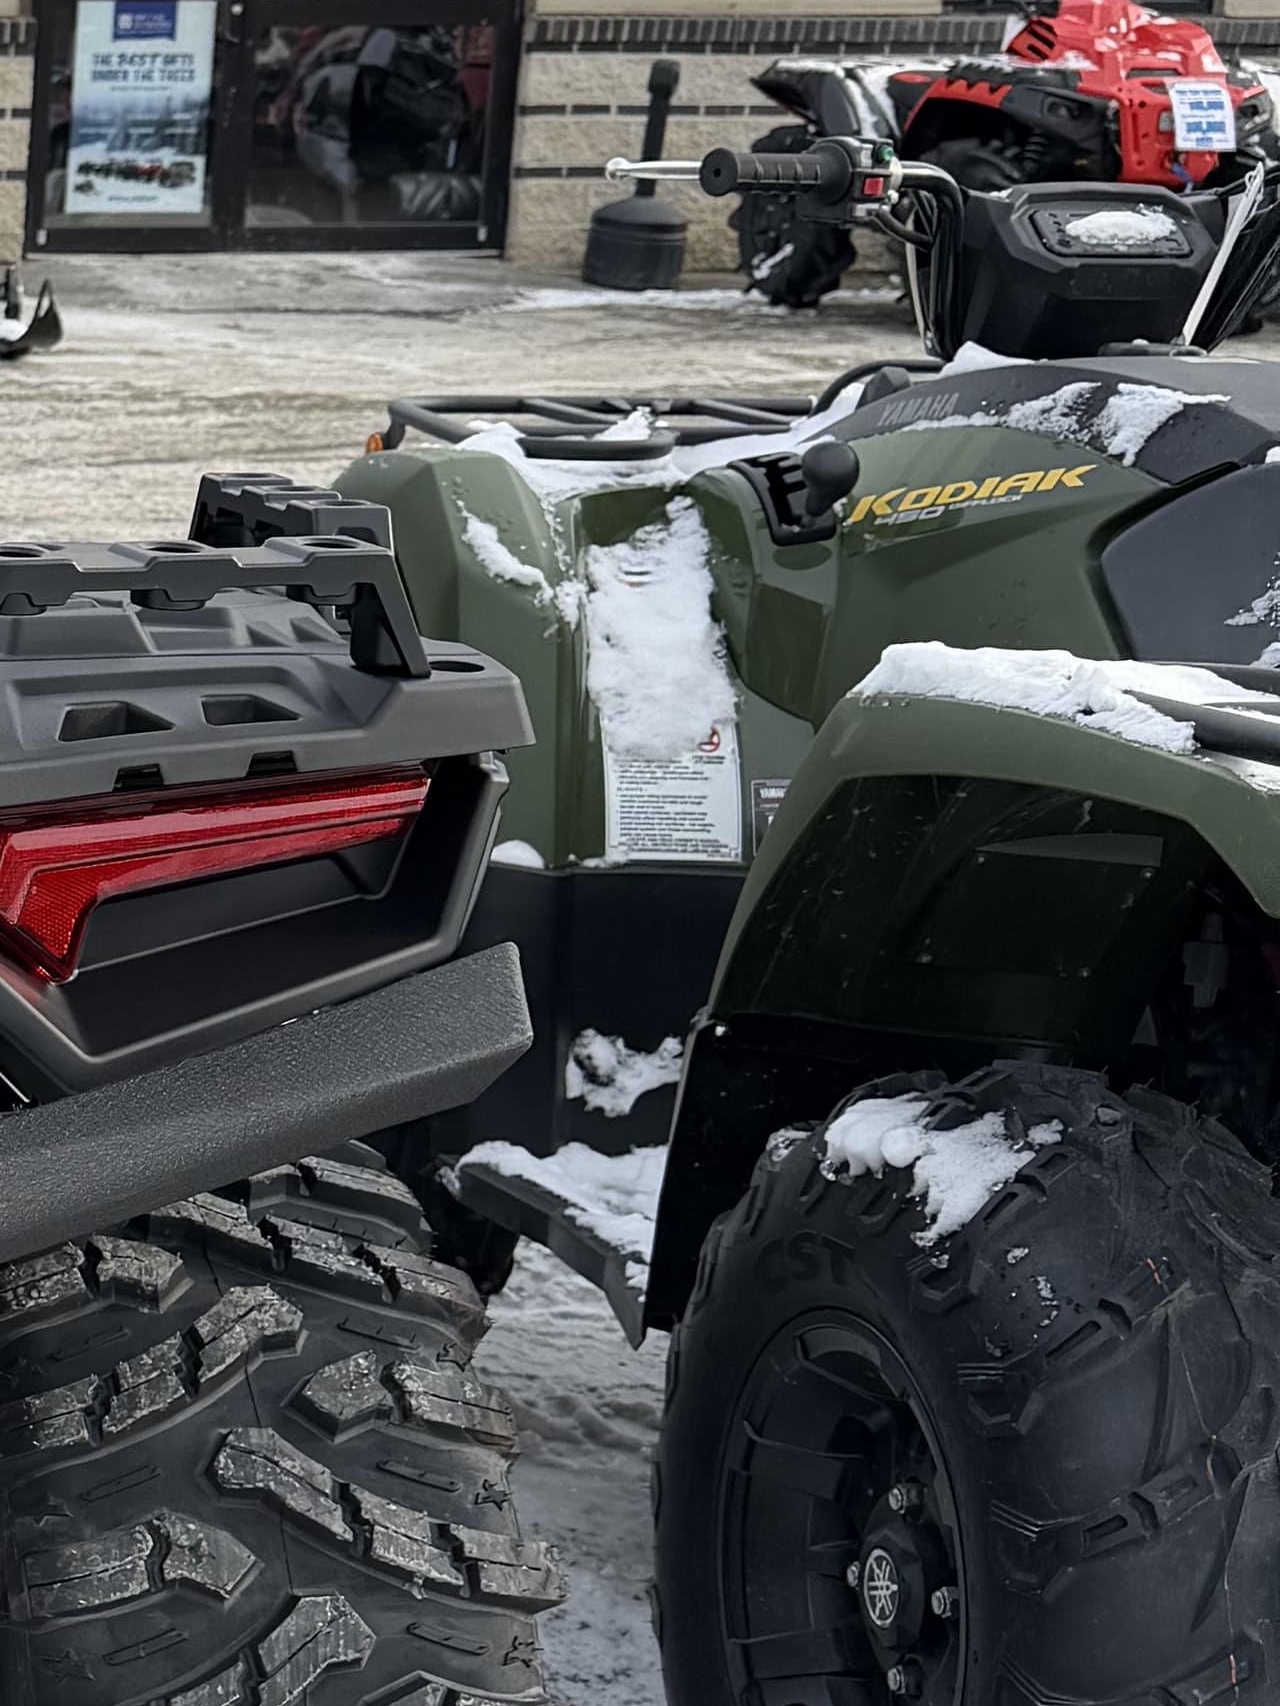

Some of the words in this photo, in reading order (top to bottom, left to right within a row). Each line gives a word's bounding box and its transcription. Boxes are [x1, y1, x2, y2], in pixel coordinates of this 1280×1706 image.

[877, 391, 961, 428] YAMAHA
[843, 464, 1098, 525] KODIAK
[873, 506, 947, 526] 450
[753, 1228, 856, 1294] CST
